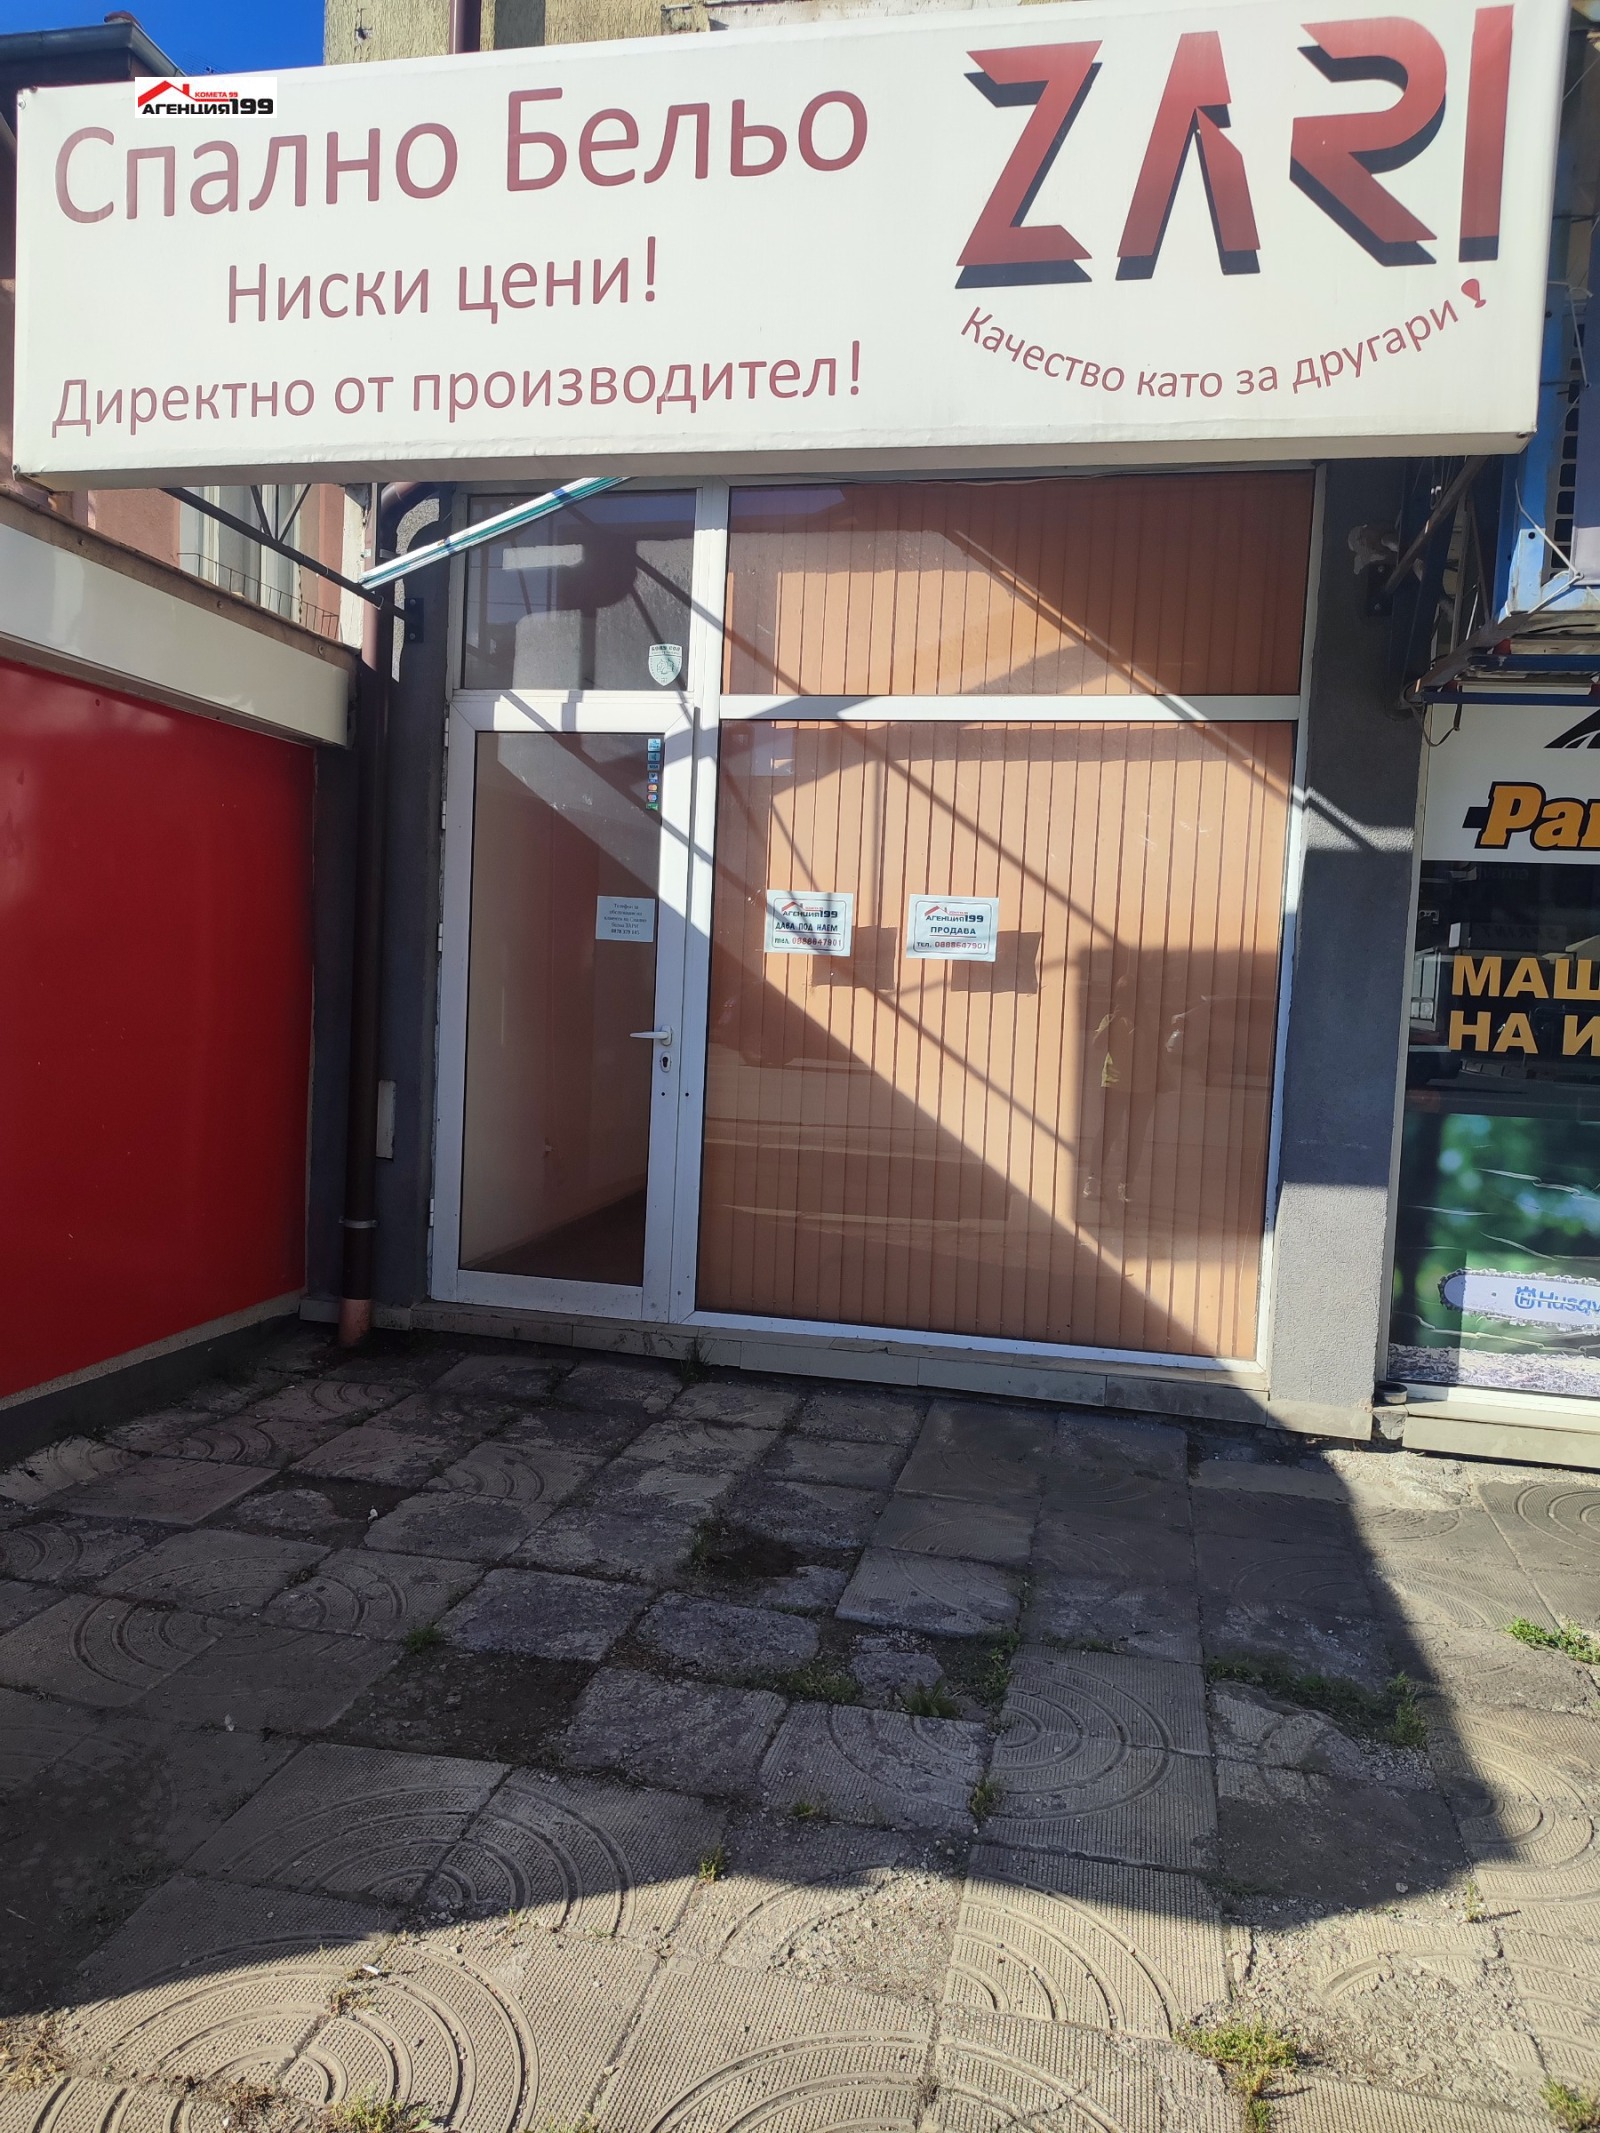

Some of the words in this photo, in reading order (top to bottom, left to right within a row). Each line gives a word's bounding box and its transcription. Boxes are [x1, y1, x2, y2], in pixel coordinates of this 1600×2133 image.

[54, 122, 458, 222] Спално
[507, 88, 868, 192] Бельо
[955, 5, 1514, 290] ZARI
[228, 265, 429, 324] Ниски
[457, 236, 657, 323] цени!
[51, 380, 315, 437] Директно
[334, 376, 393, 414] от
[412, 341, 861, 422] производител!
[960, 306, 1125, 393] Качество
[1136, 371, 1223, 399] като
[1235, 367, 1279, 395] за
[774, 921, 796, 931] ДАВА
[798, 922, 813, 931] ПОД
[816, 923, 838, 932] НАЕМ
[930, 926, 977, 935] ПРОДАВА
[934, 940, 987, 950] 0888647901
[1449, 1010, 1538, 1054] НА
